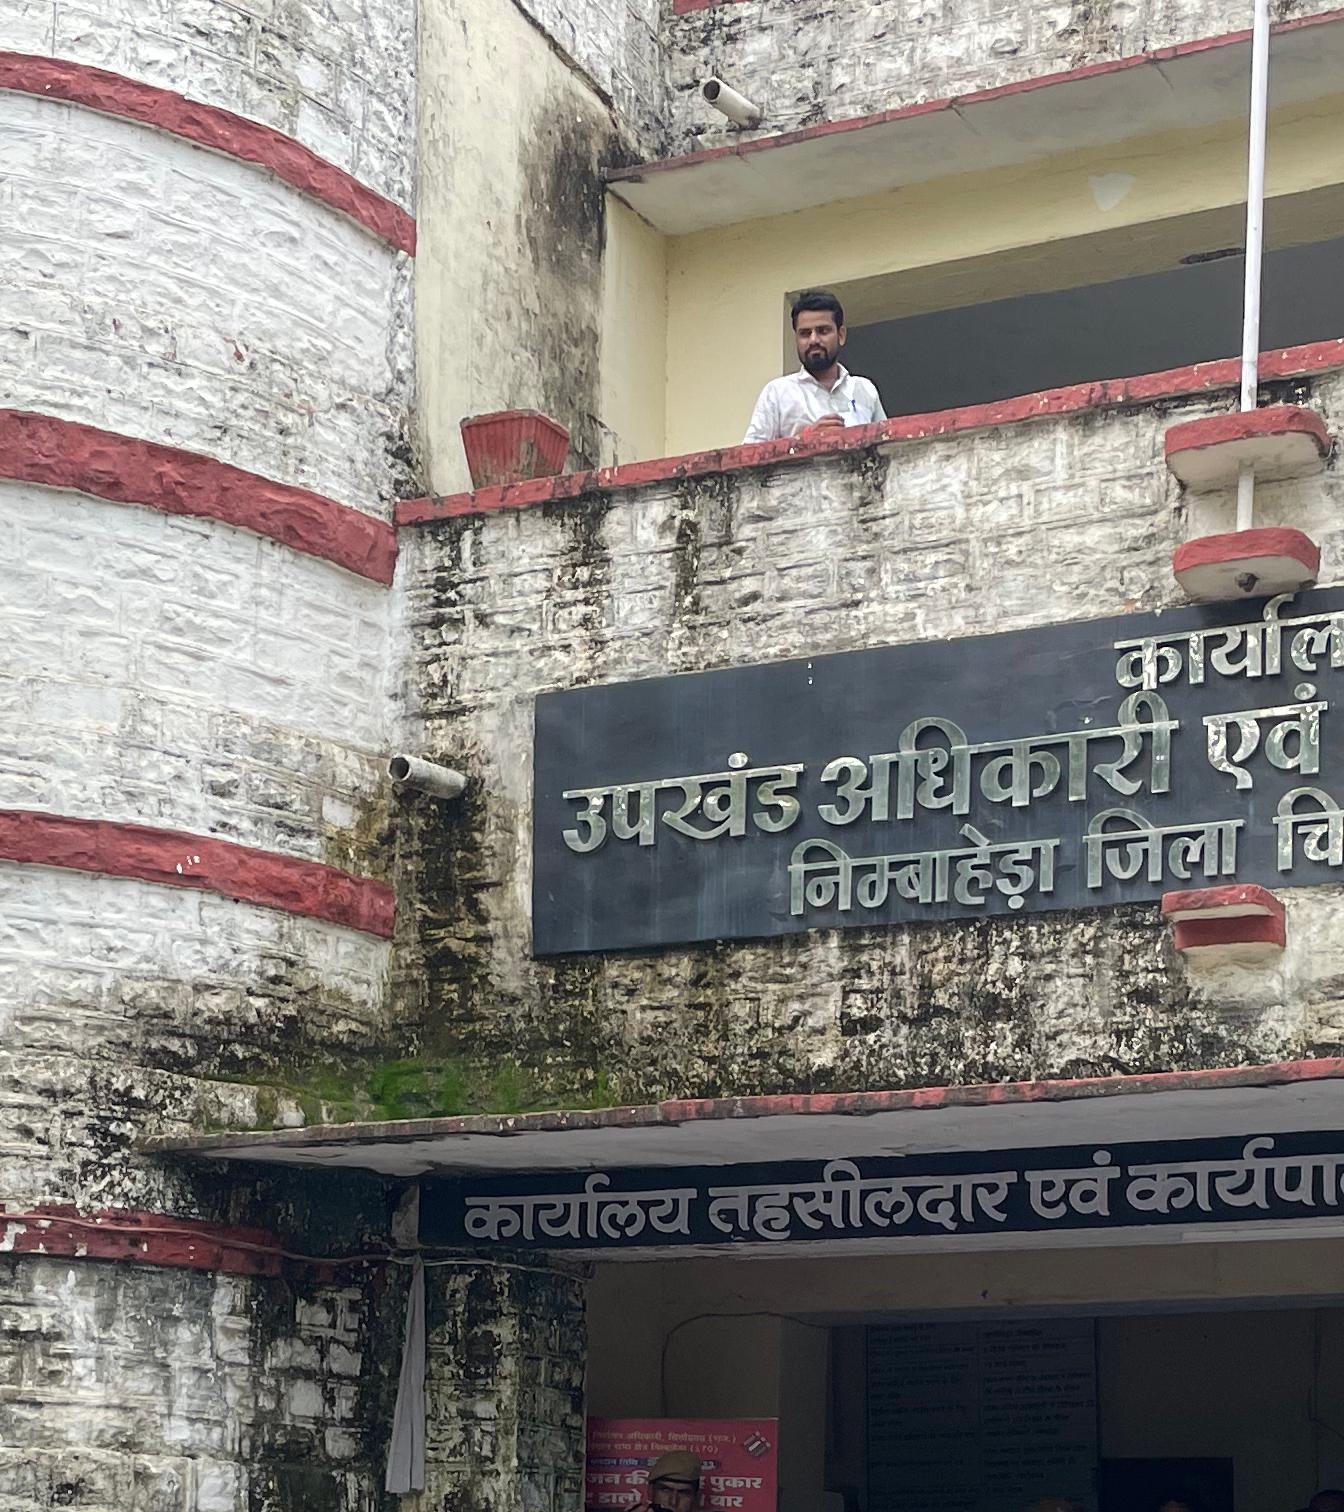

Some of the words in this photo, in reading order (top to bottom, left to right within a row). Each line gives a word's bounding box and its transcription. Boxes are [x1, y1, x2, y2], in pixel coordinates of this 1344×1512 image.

[562, 752, 804, 853] उपखंड
[817, 691, 1179, 825] अधिकारी
[1203, 682, 1328, 790] एवं
[788, 824, 1060, 912] निम्बाहेड़ा
[1083, 806, 1246, 890] जिला
[464, 1174, 697, 1241] कार्यालय
[708, 1158, 1017, 1241] तहसीलदार
[1025, 1150, 1120, 1219] एवं
[710, 1475, 763, 1492] पुकार
